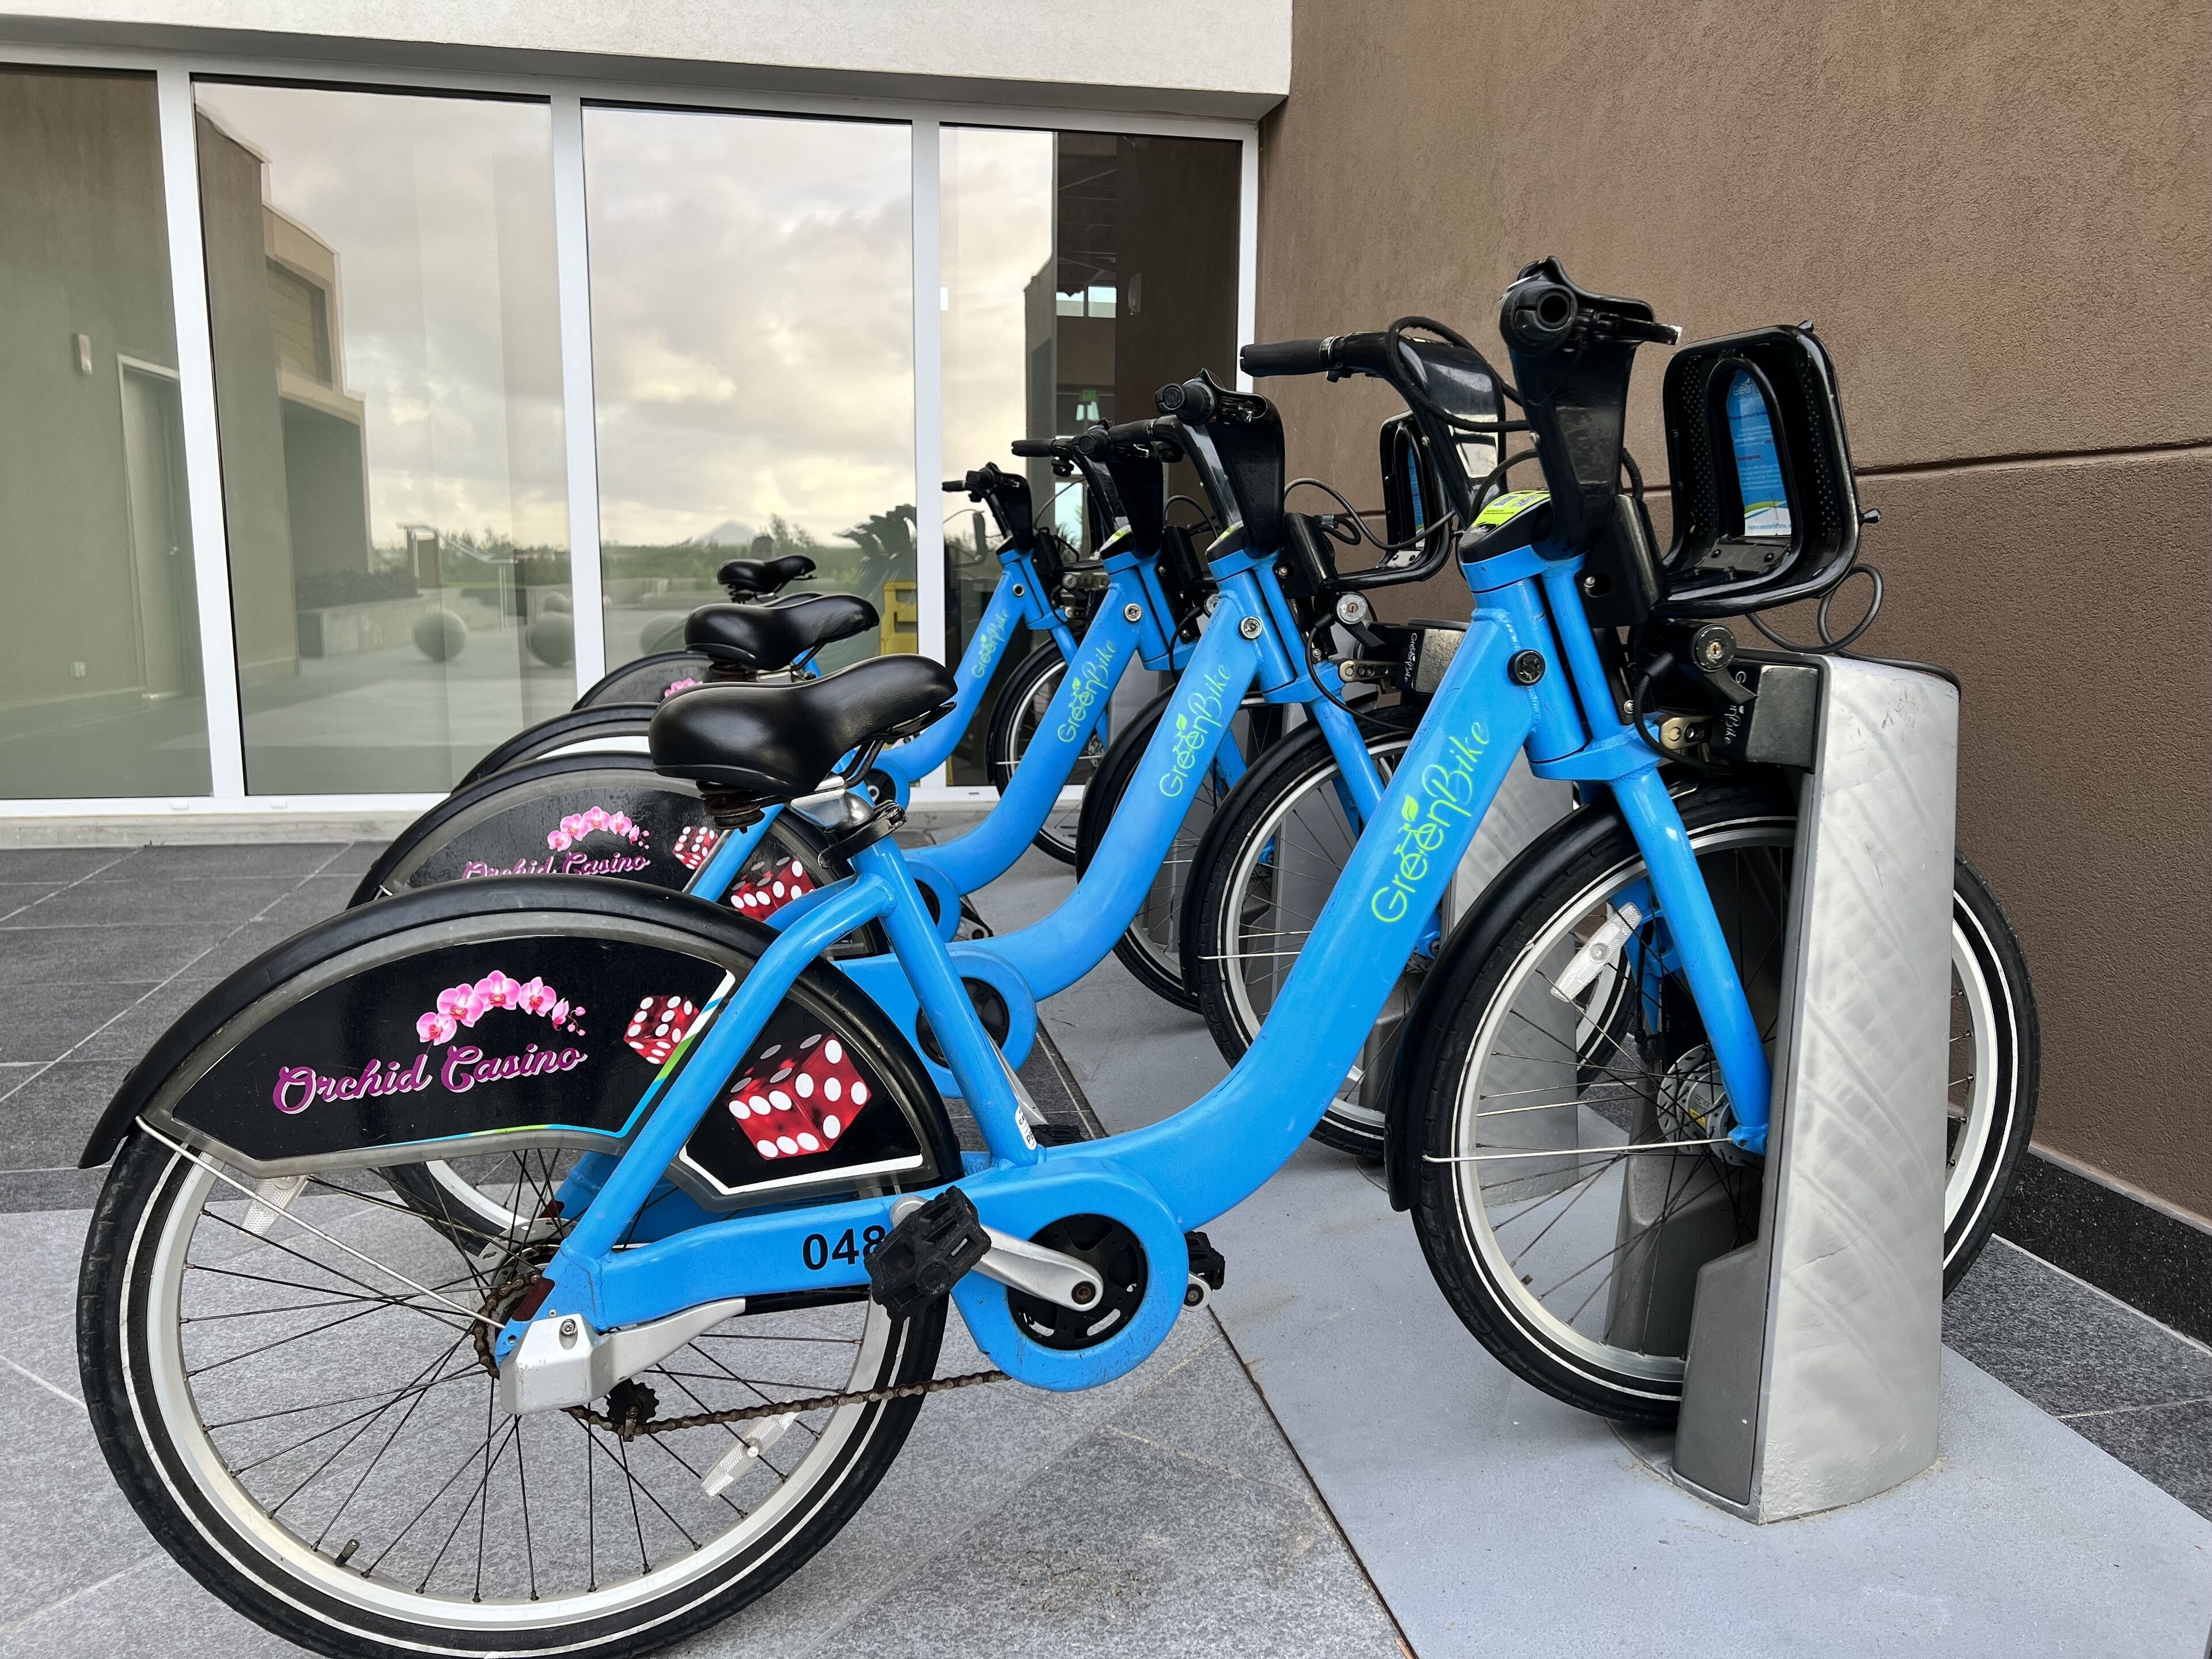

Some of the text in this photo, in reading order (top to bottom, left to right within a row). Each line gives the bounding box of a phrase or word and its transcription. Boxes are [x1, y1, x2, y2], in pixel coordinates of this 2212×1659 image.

[971, 609, 1009, 678] GreenBike
[1056, 639, 1116, 743] GreenBike
[1159, 664, 1233, 798] GreenBike
[562, 851, 652, 875] Casino
[1371, 721, 1493, 923] GreenBike
[273, 1043, 588, 1115] Orchid Casino
